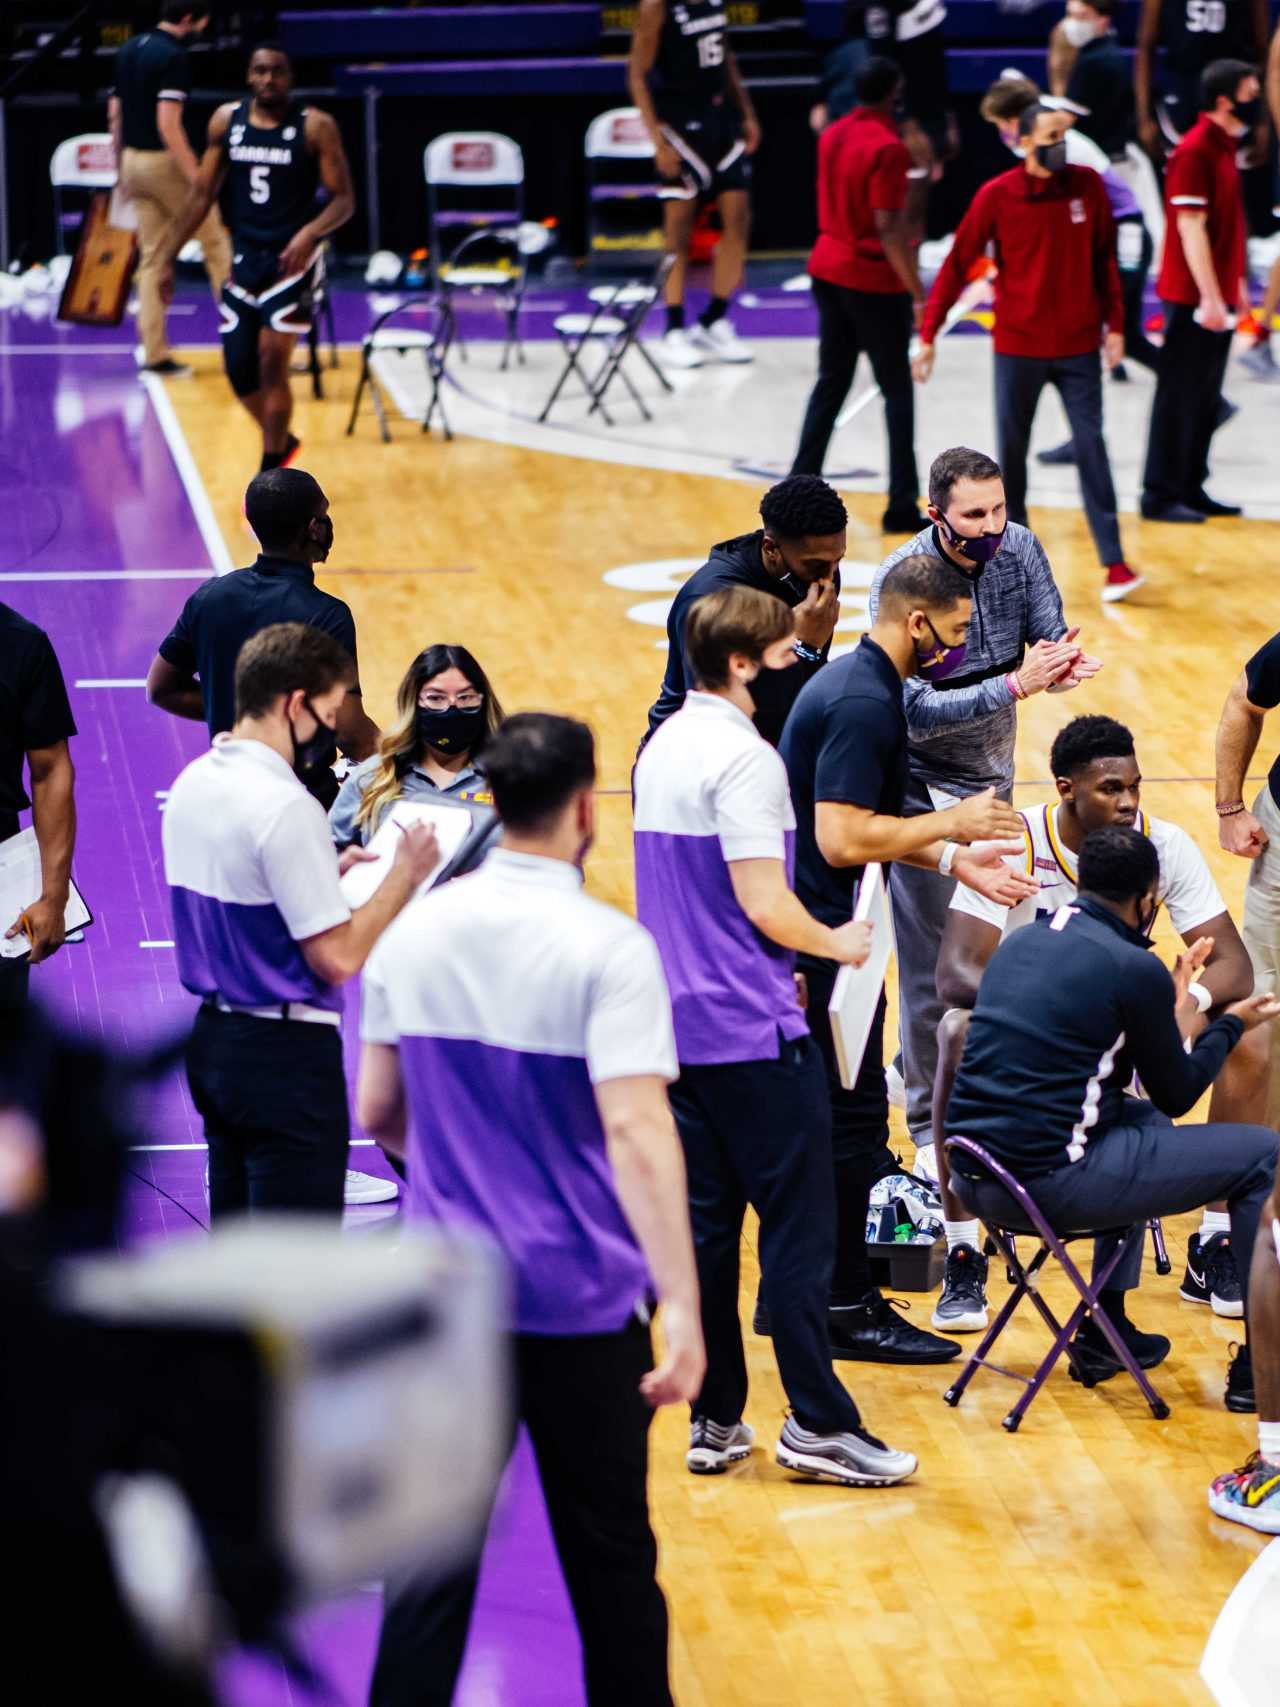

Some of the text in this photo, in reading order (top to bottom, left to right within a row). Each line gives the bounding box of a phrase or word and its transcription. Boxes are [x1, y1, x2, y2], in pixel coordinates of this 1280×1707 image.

[1186, 0, 1226, 33] 50
[697, 33, 725, 67] 15
[250, 166, 270, 204] 5
